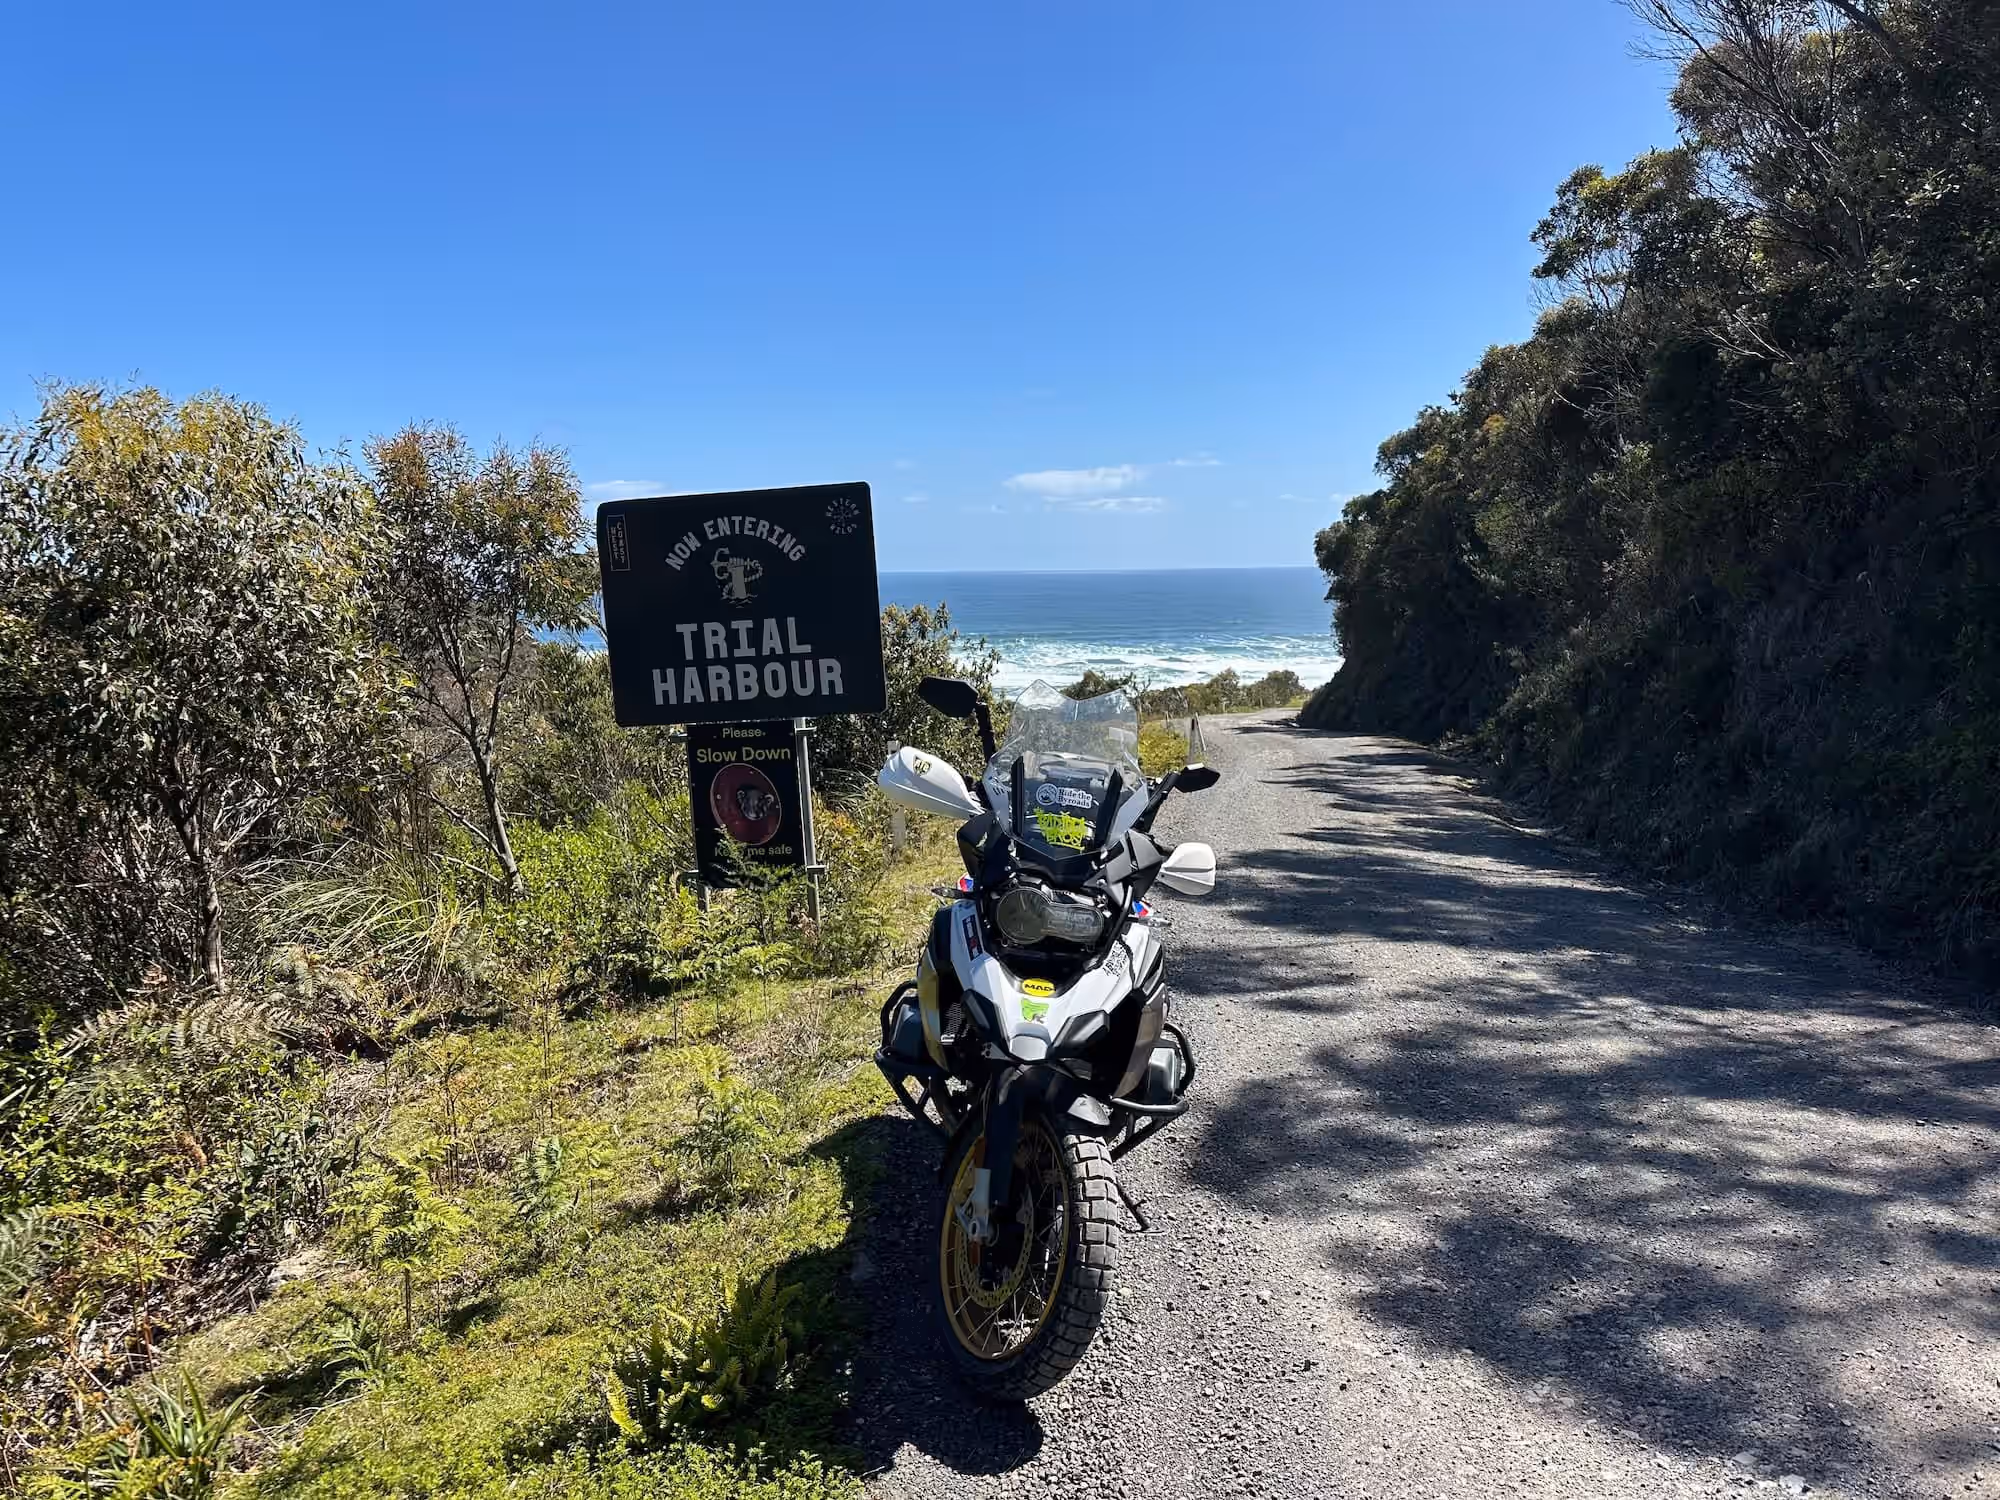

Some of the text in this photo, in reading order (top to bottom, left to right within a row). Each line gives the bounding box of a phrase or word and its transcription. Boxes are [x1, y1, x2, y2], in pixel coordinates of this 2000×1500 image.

[664, 515, 806, 571] NOW ENTERING
[675, 616, 812, 661] TRIAL
[652, 658, 844, 706] HARBOUR
[722, 727, 762, 739] Please
[696, 746, 791, 763] Slow Down
[1058, 788, 1077, 798] Ride
[1058, 795, 1090, 807] Byroads
[747, 846, 765, 856] me
[768, 844, 793, 856] safe
